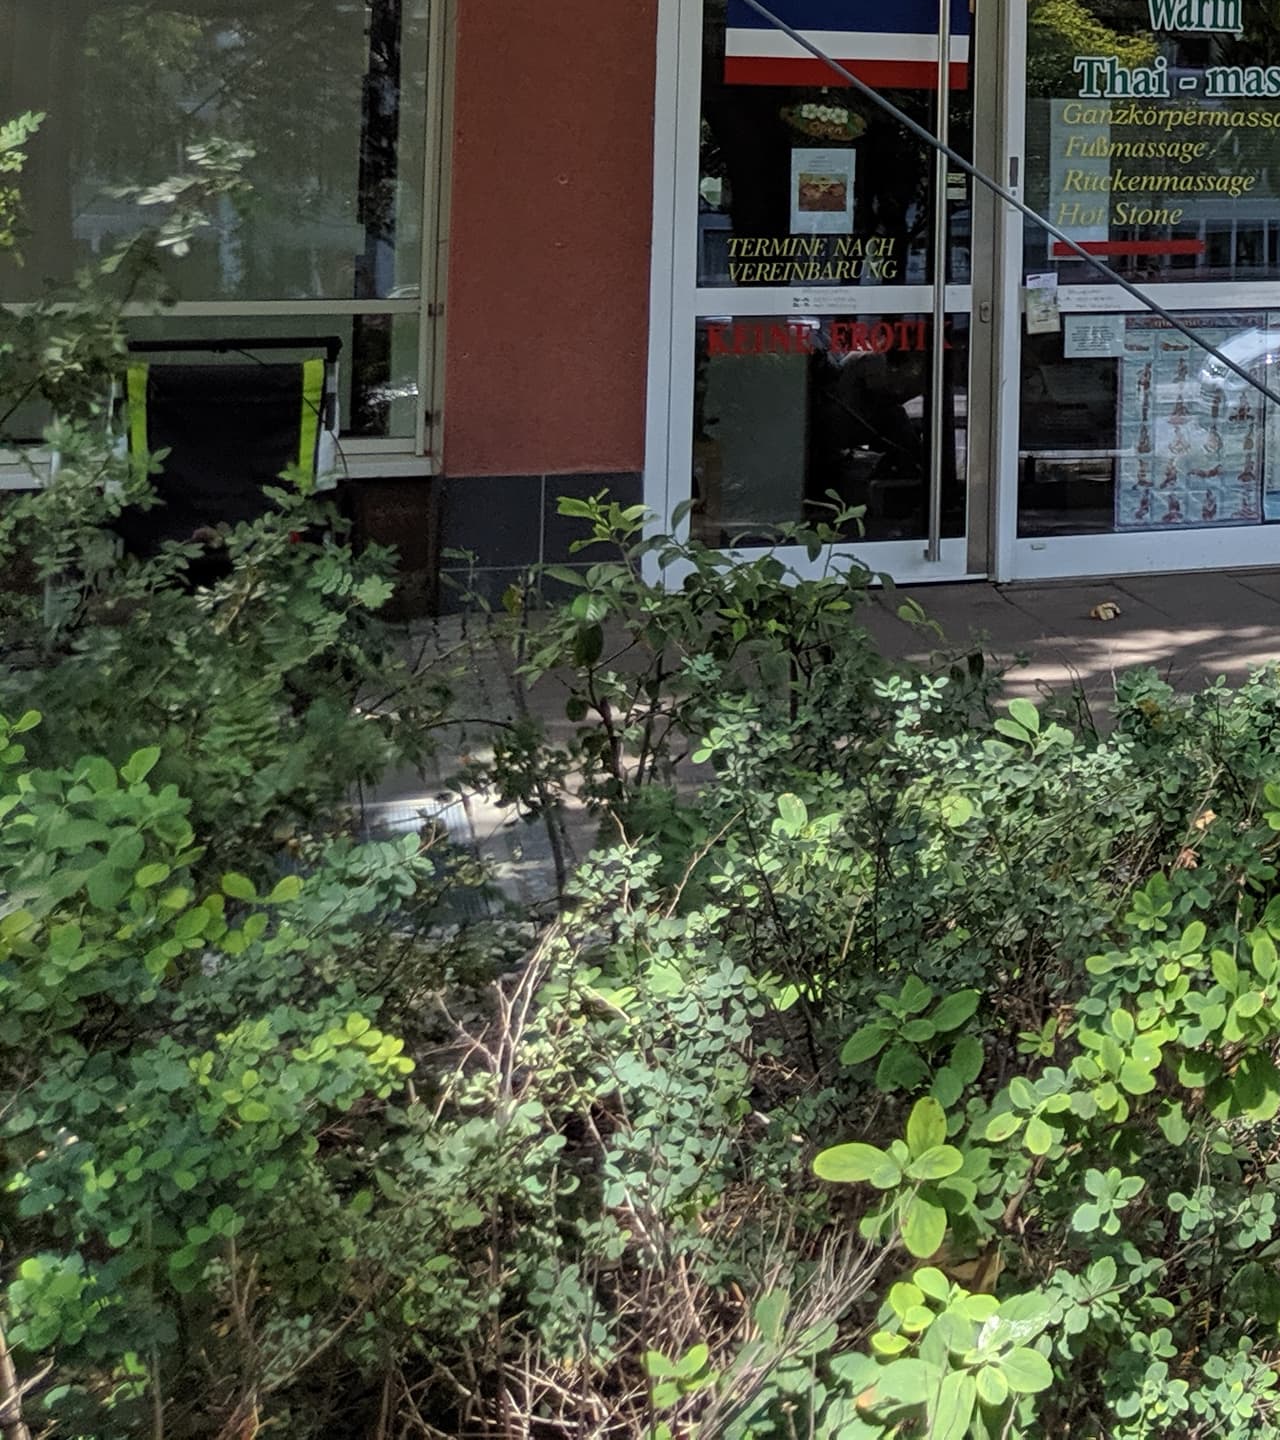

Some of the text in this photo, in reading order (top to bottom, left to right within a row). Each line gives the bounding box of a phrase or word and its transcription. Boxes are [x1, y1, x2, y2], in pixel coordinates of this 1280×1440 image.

[1074, 56, 1170, 98] Thai
[1064, 136, 1206, 164] Fußmassage
[1063, 168, 1256, 197] Rückenmassage
[1112, 201, 1184, 227] Stone
[727, 237, 896, 258] TERMINE NACH
[727, 260, 898, 282] VEREINBARUNG
[705, 322, 814, 355] KEINE
